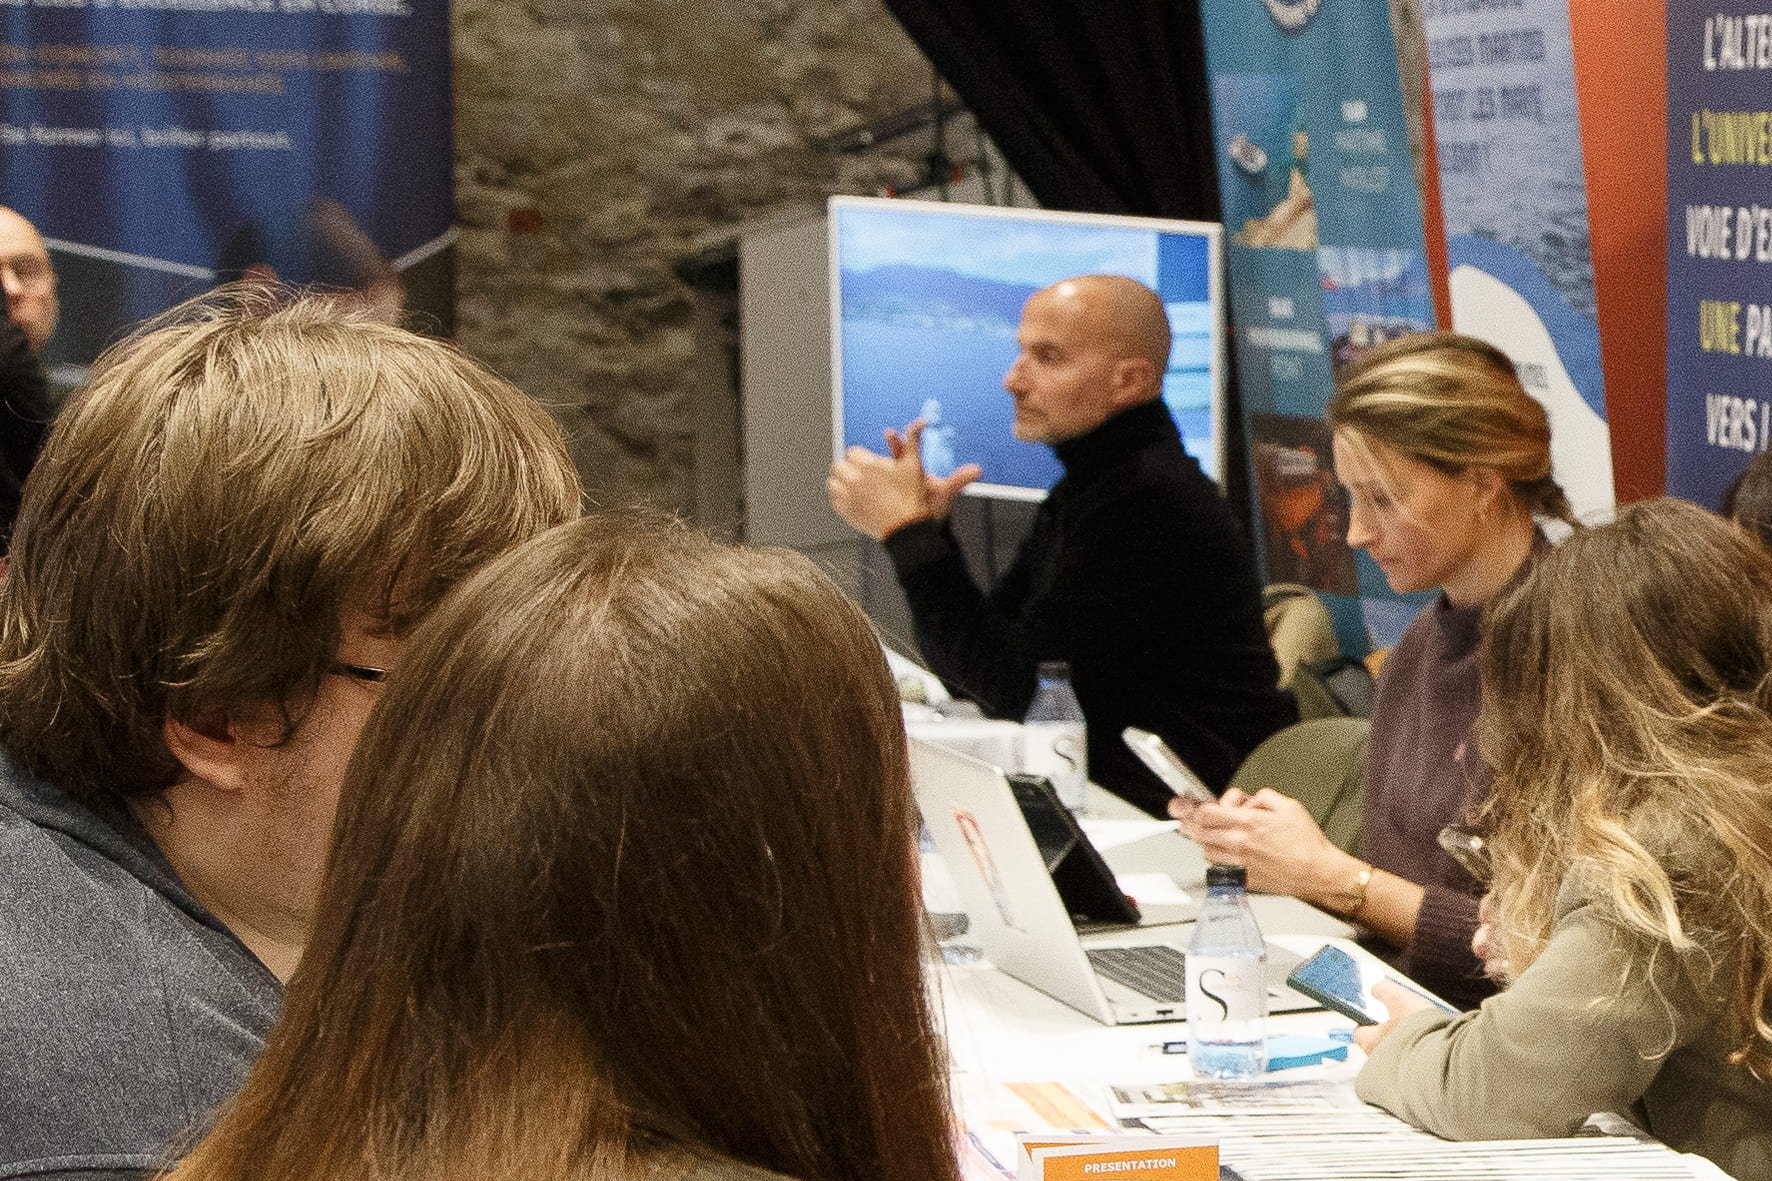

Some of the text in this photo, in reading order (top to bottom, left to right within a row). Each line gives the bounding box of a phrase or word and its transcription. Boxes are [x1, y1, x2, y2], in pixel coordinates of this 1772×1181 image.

[1685, 204, 1733, 260] VOIE
[1700, 300, 1740, 354] UNE
[1706, 393, 1757, 452] VERS
[1084, 1158, 1177, 1174] PRESENTATION
